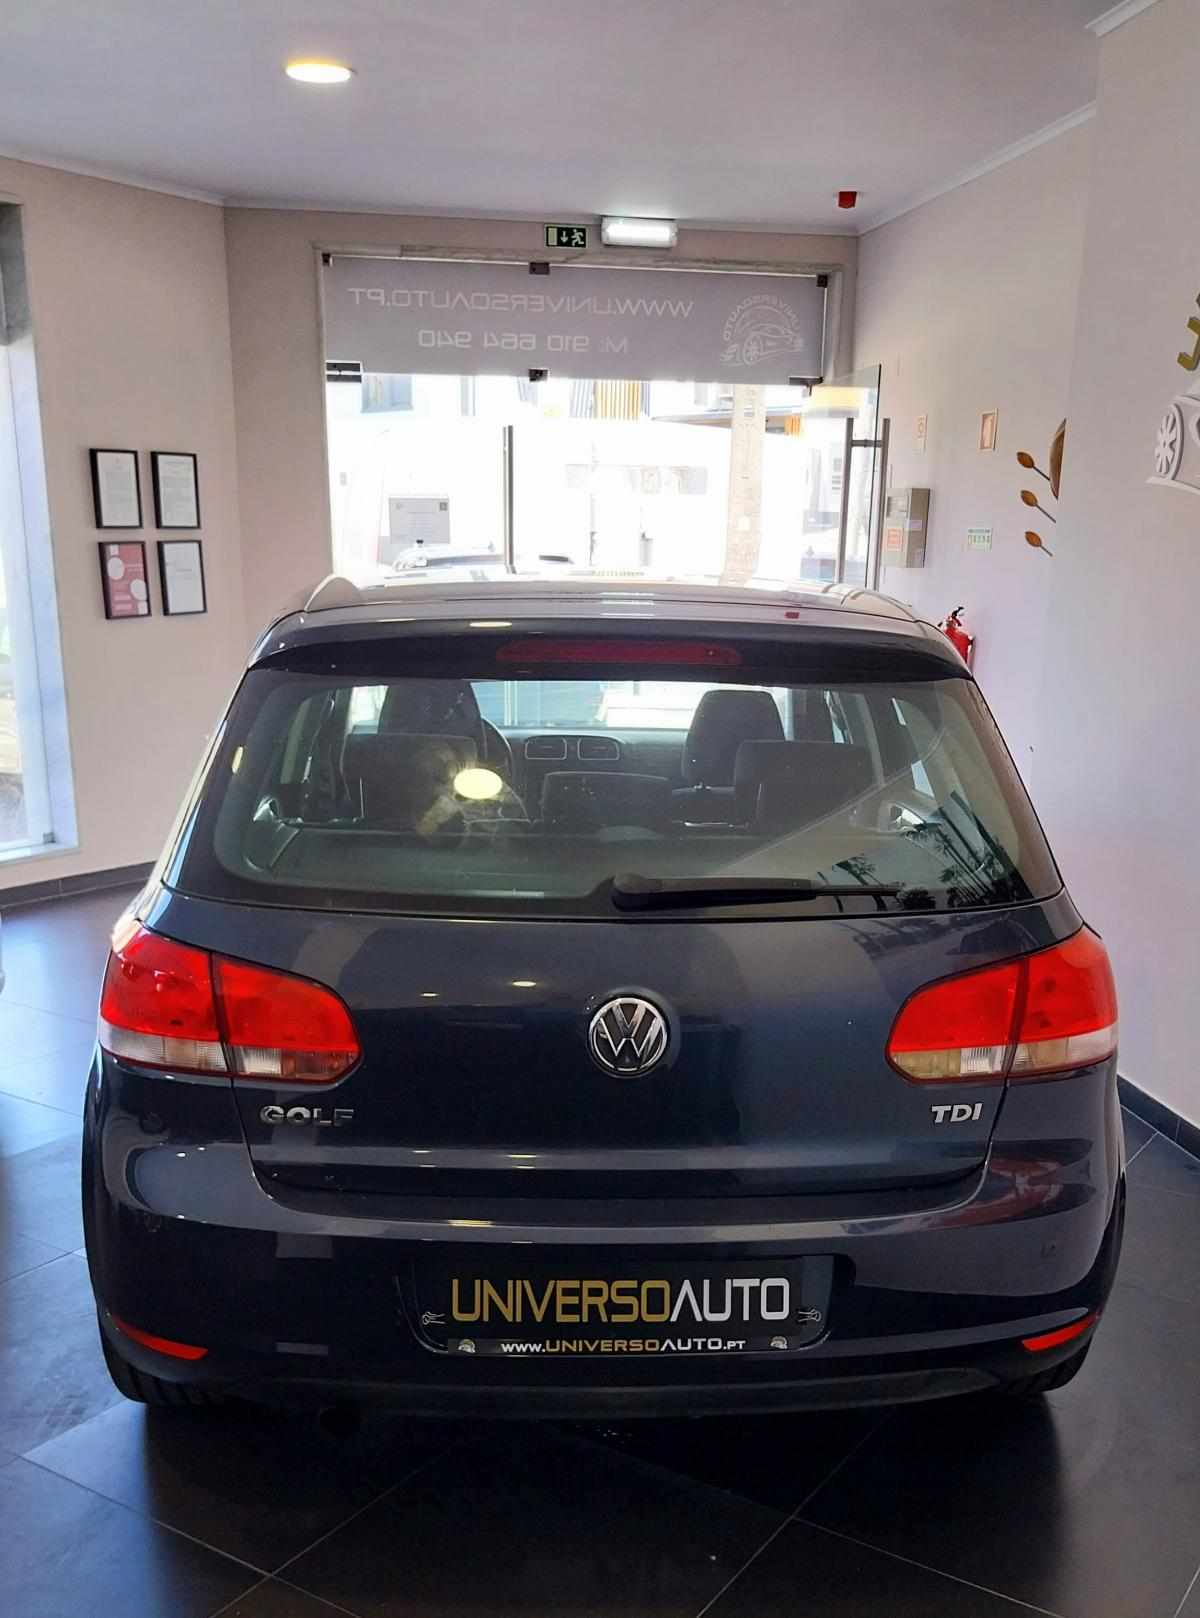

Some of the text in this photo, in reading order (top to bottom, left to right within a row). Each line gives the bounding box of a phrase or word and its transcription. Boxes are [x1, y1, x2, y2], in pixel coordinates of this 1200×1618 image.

[260, 1105, 354, 1127] GOLF
[931, 1102, 983, 1124] TDI
[452, 1277, 790, 1323] UNIVERSOAUTO
